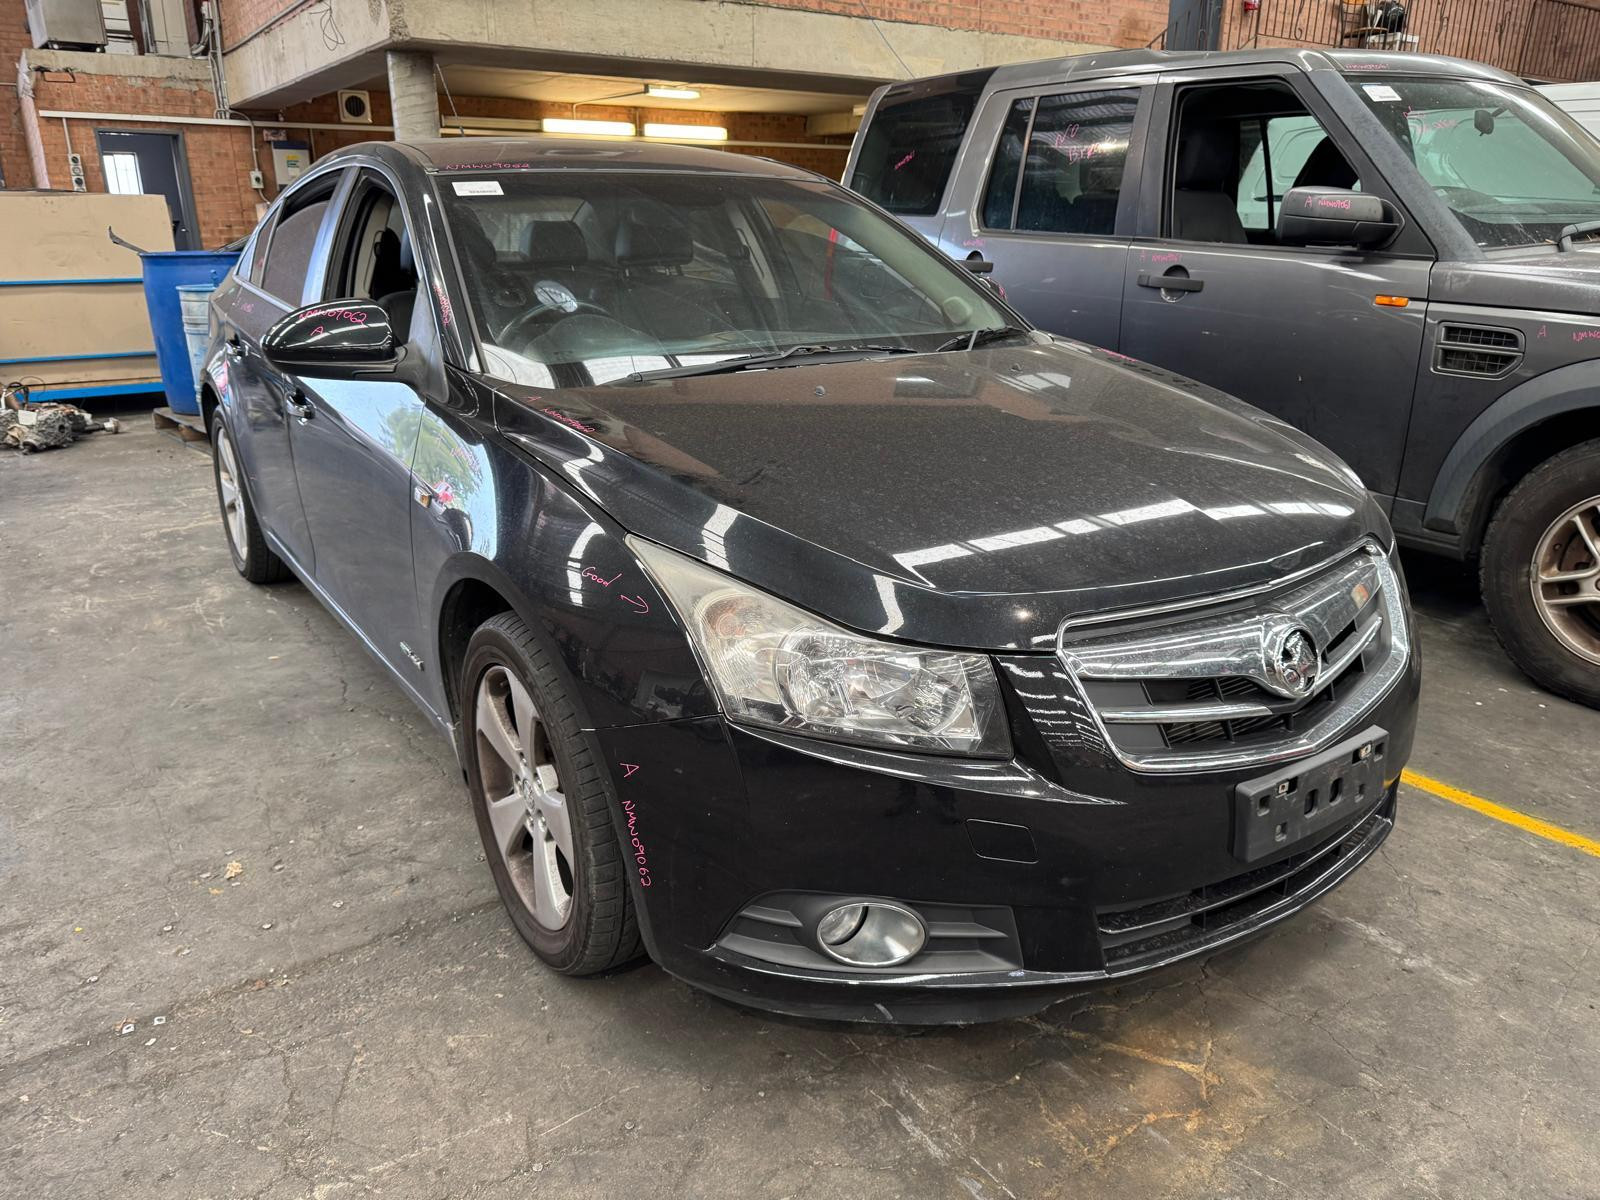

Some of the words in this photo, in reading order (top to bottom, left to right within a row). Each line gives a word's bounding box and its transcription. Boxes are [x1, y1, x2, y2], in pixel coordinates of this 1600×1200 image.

[310, 325, 324, 337] A
[581, 566, 623, 588] Good
[619, 762, 640, 779] A
[621, 800, 652, 887] NMW09062
